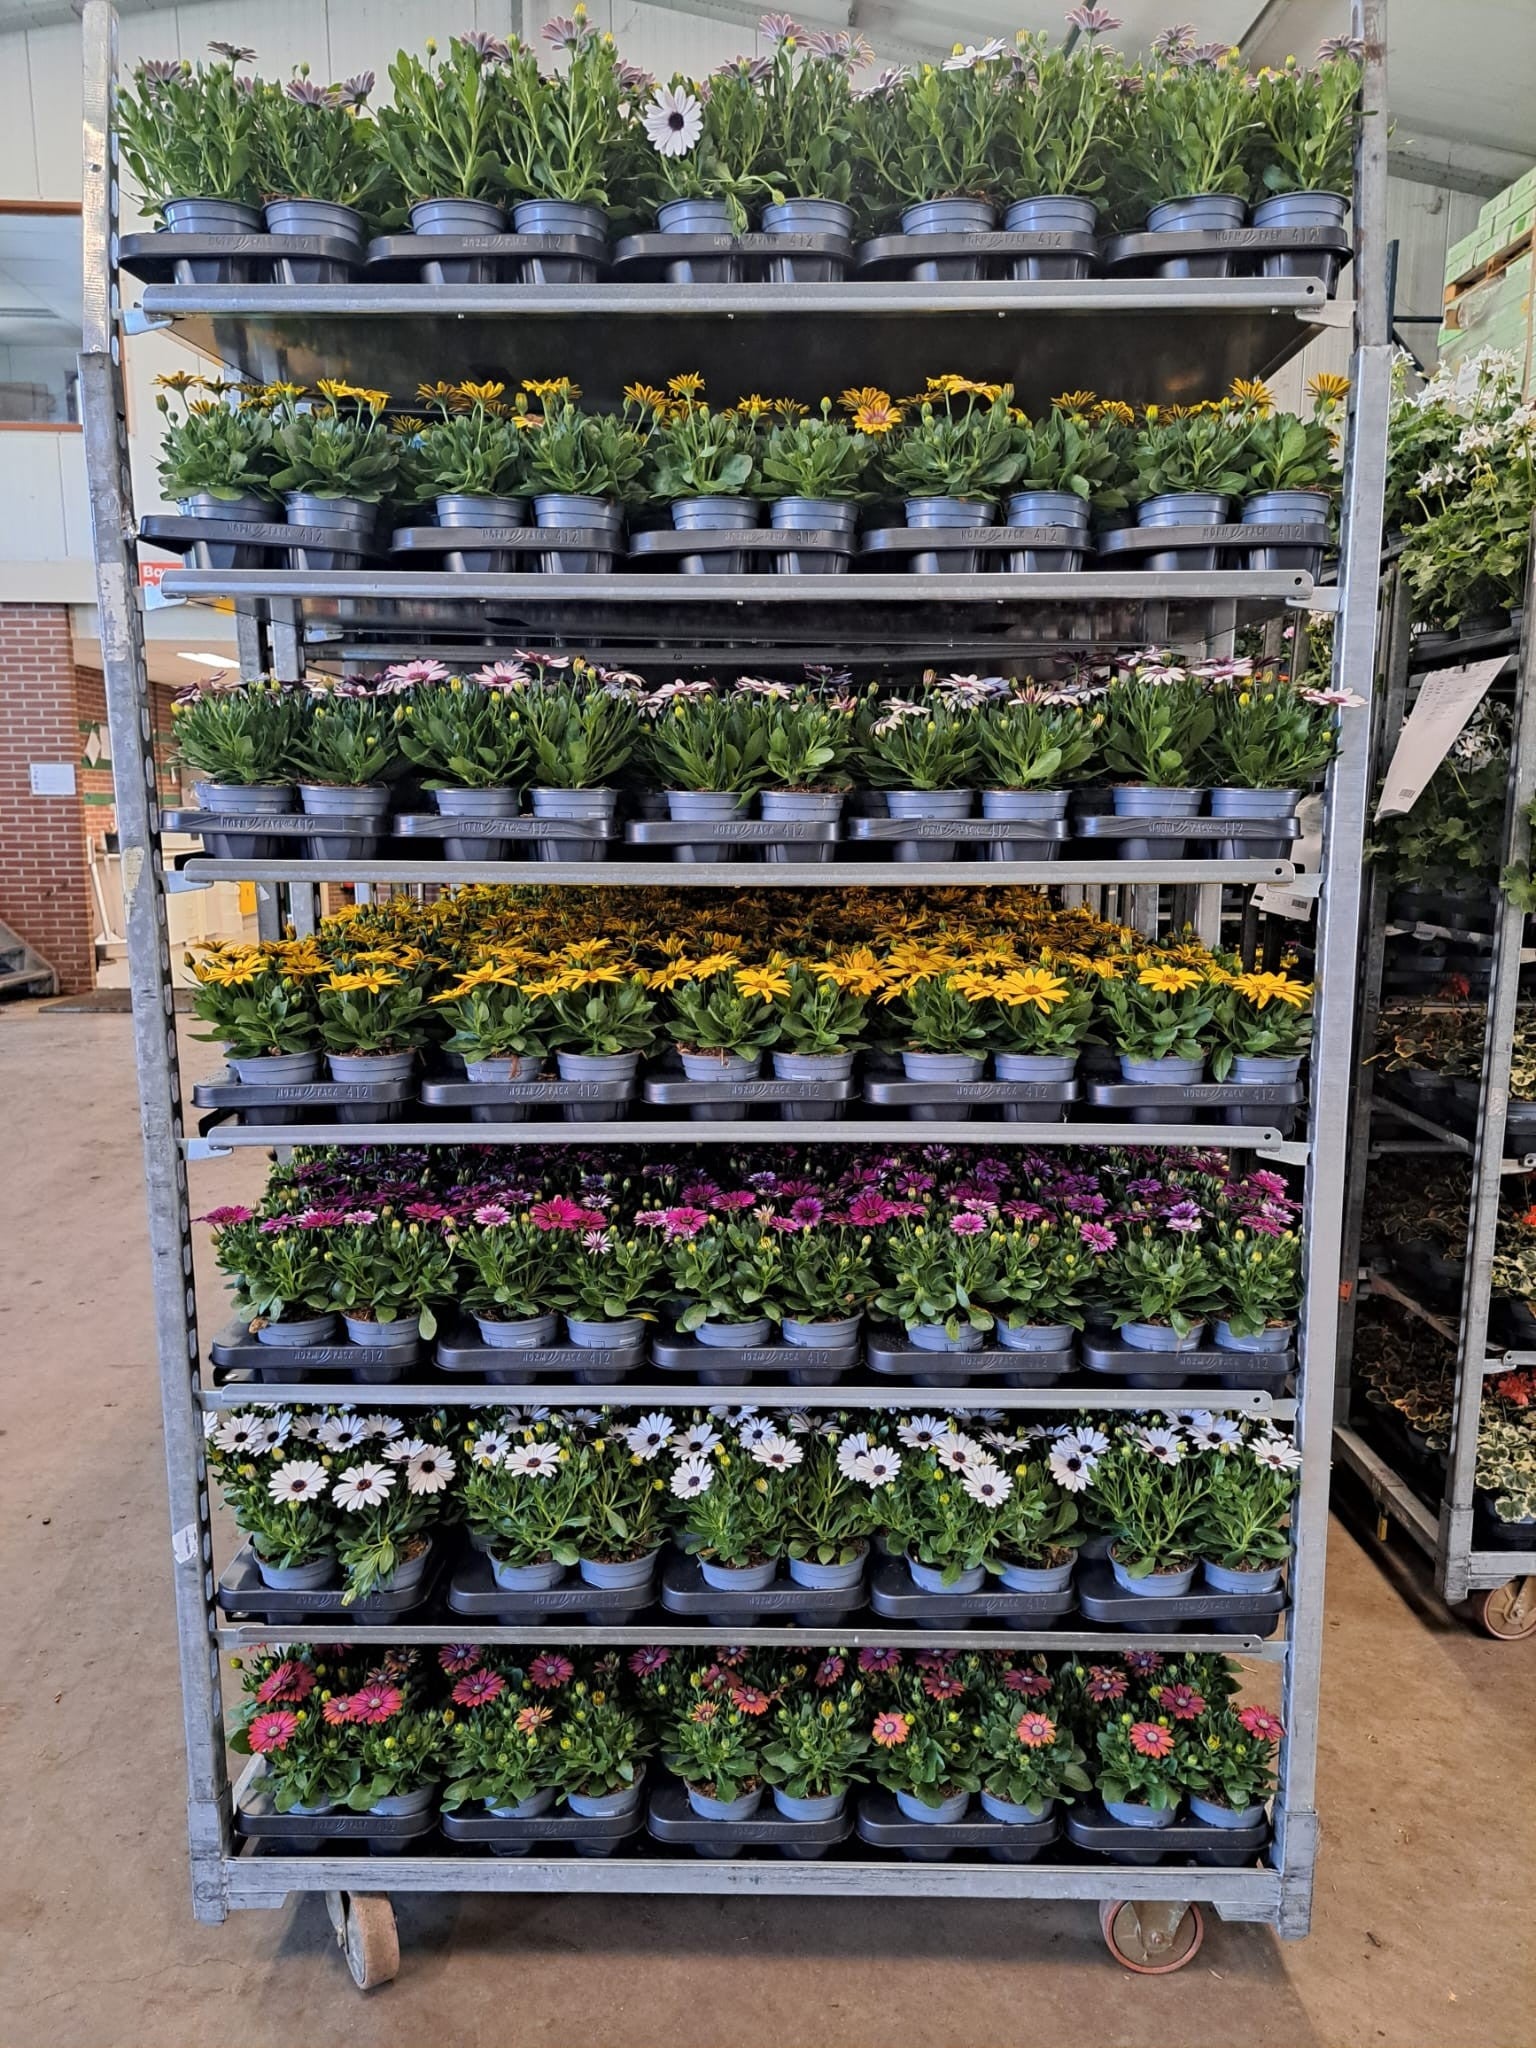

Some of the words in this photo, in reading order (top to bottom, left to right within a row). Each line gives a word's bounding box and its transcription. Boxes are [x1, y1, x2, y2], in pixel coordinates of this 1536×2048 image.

[789, 234, 813, 247] 412
[1037, 232, 1062, 246] 412
[1292, 228, 1315, 242] 412
[300, 527, 324, 544] 412
[556, 529, 580, 545] 412
[1033, 528, 1057, 543] 412
[1278, 524, 1302, 540] 412
[782, 823, 806, 839] 412
[347, 1085, 369, 1099] 412
[577, 1084, 599, 1097] 412
[798, 1084, 820, 1097] 412
[1026, 1085, 1048, 1098] 412
[1252, 1087, 1274, 1101] 412
[361, 1350, 383, 1363] 412
[590, 1351, 613, 1365] 412
[808, 1351, 830, 1364] 412
[1247, 1356, 1269, 1369] 412
